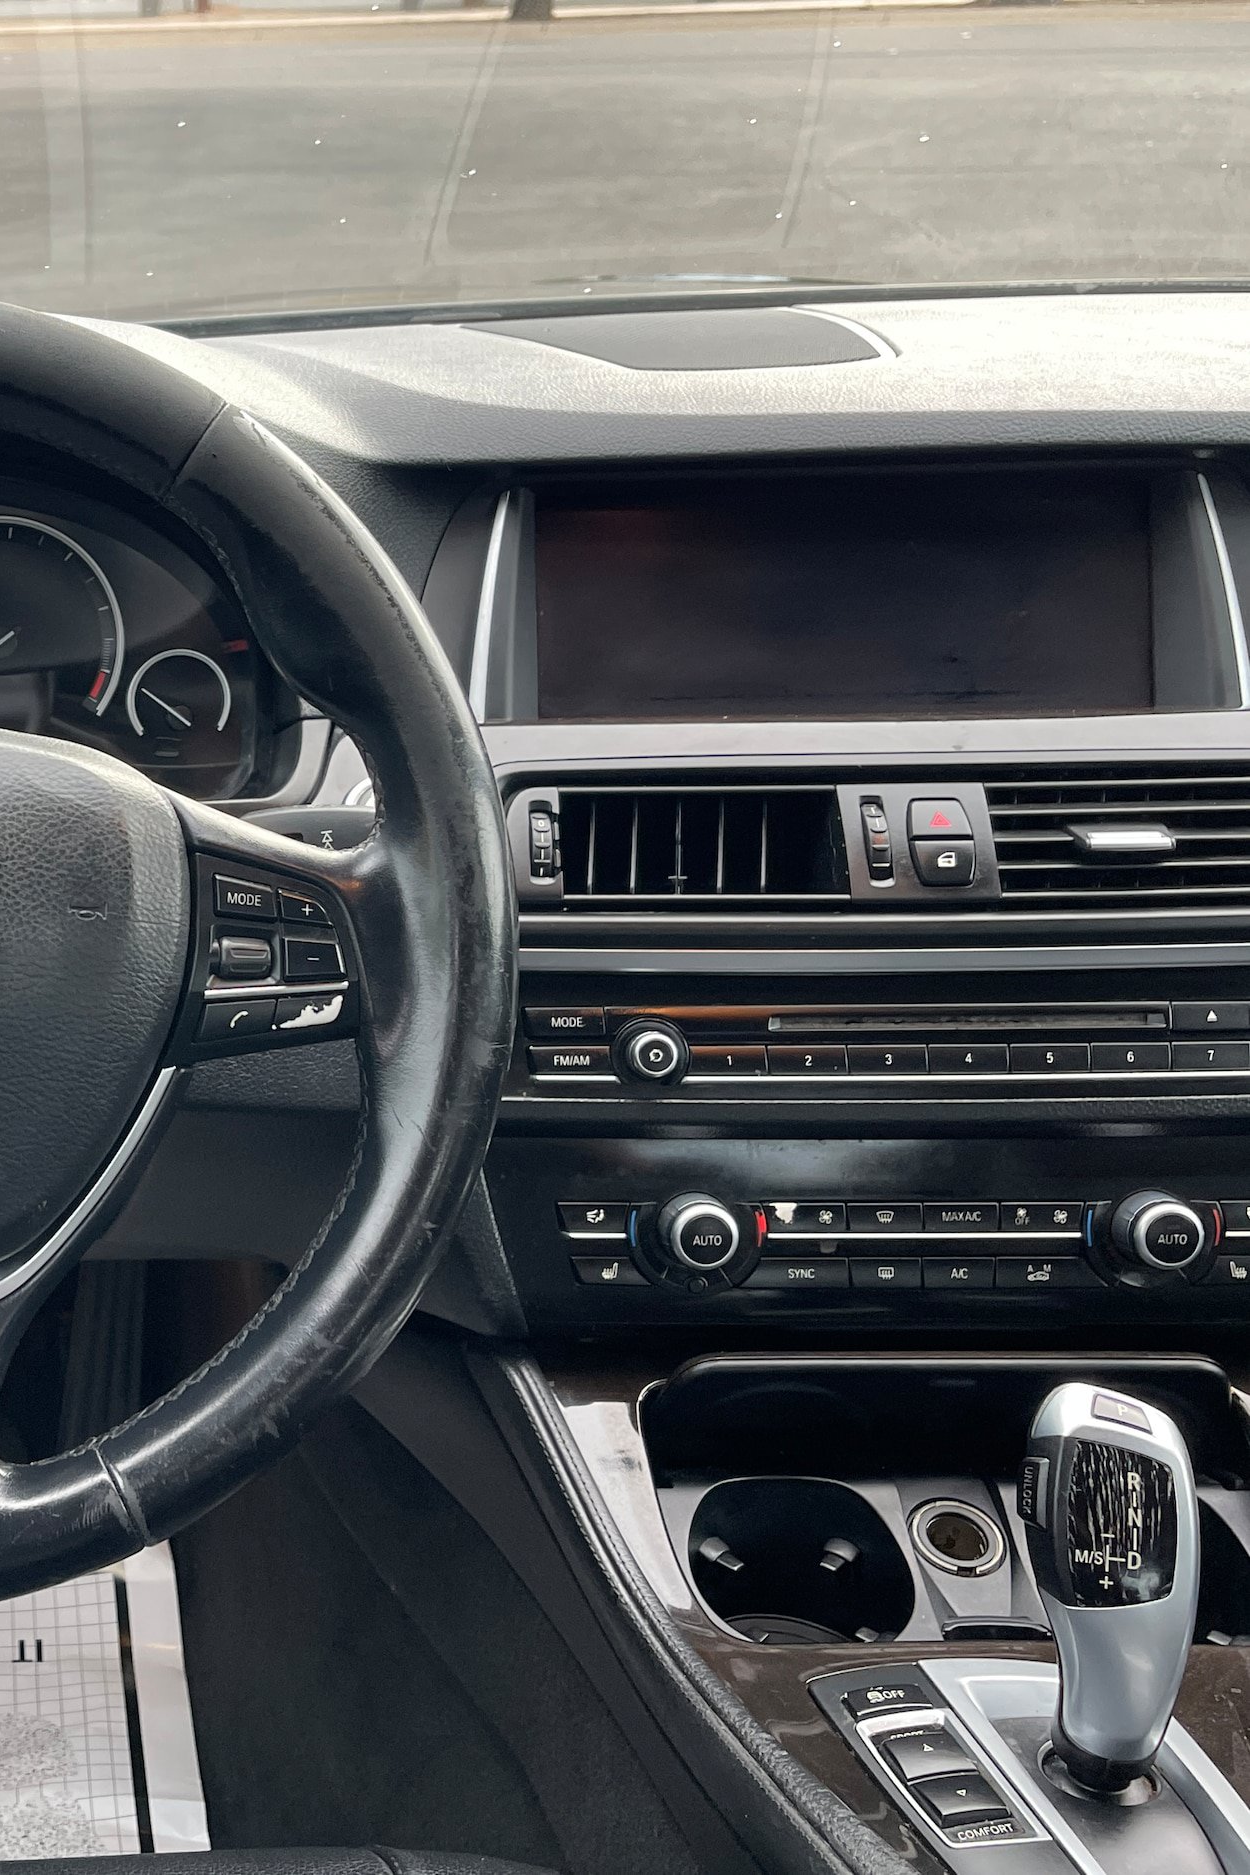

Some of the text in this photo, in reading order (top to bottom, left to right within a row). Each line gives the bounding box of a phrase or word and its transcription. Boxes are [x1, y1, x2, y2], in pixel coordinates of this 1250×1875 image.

[226, 891, 262, 907] MODE
[551, 1016, 584, 1028] MODE
[553, 1055, 590, 1067] FM/AM
[726, 1055, 732, 1066] 1
[805, 1055, 812, 1067] 2
[885, 1054, 892, 1065] 3
[965, 1052, 972, 1064] 4
[1046, 1052, 1054, 1063] 5
[1127, 1051, 1134, 1063] 6
[1207, 1050, 1214, 1062] 7
[942, 1210, 981, 1222] MAX A/C
[692, 1234, 723, 1247] AUTO
[1157, 1233, 1188, 1246] AUTO
[788, 1268, 815, 1279] SYNC
[950, 1267, 969, 1280] A/C
[1117, 1404, 1128, 1416] P
[1127, 1471, 1141, 1492] R
[1022, 1465, 1034, 1515] UNLOCK
[1127, 1508, 1142, 1528] N
[1074, 1549, 1142, 1570] M/S D
[12, 1640, 44, 1663] IT
[883, 1690, 905, 1699] OFF
[957, 1823, 1014, 1841] COMFORT
